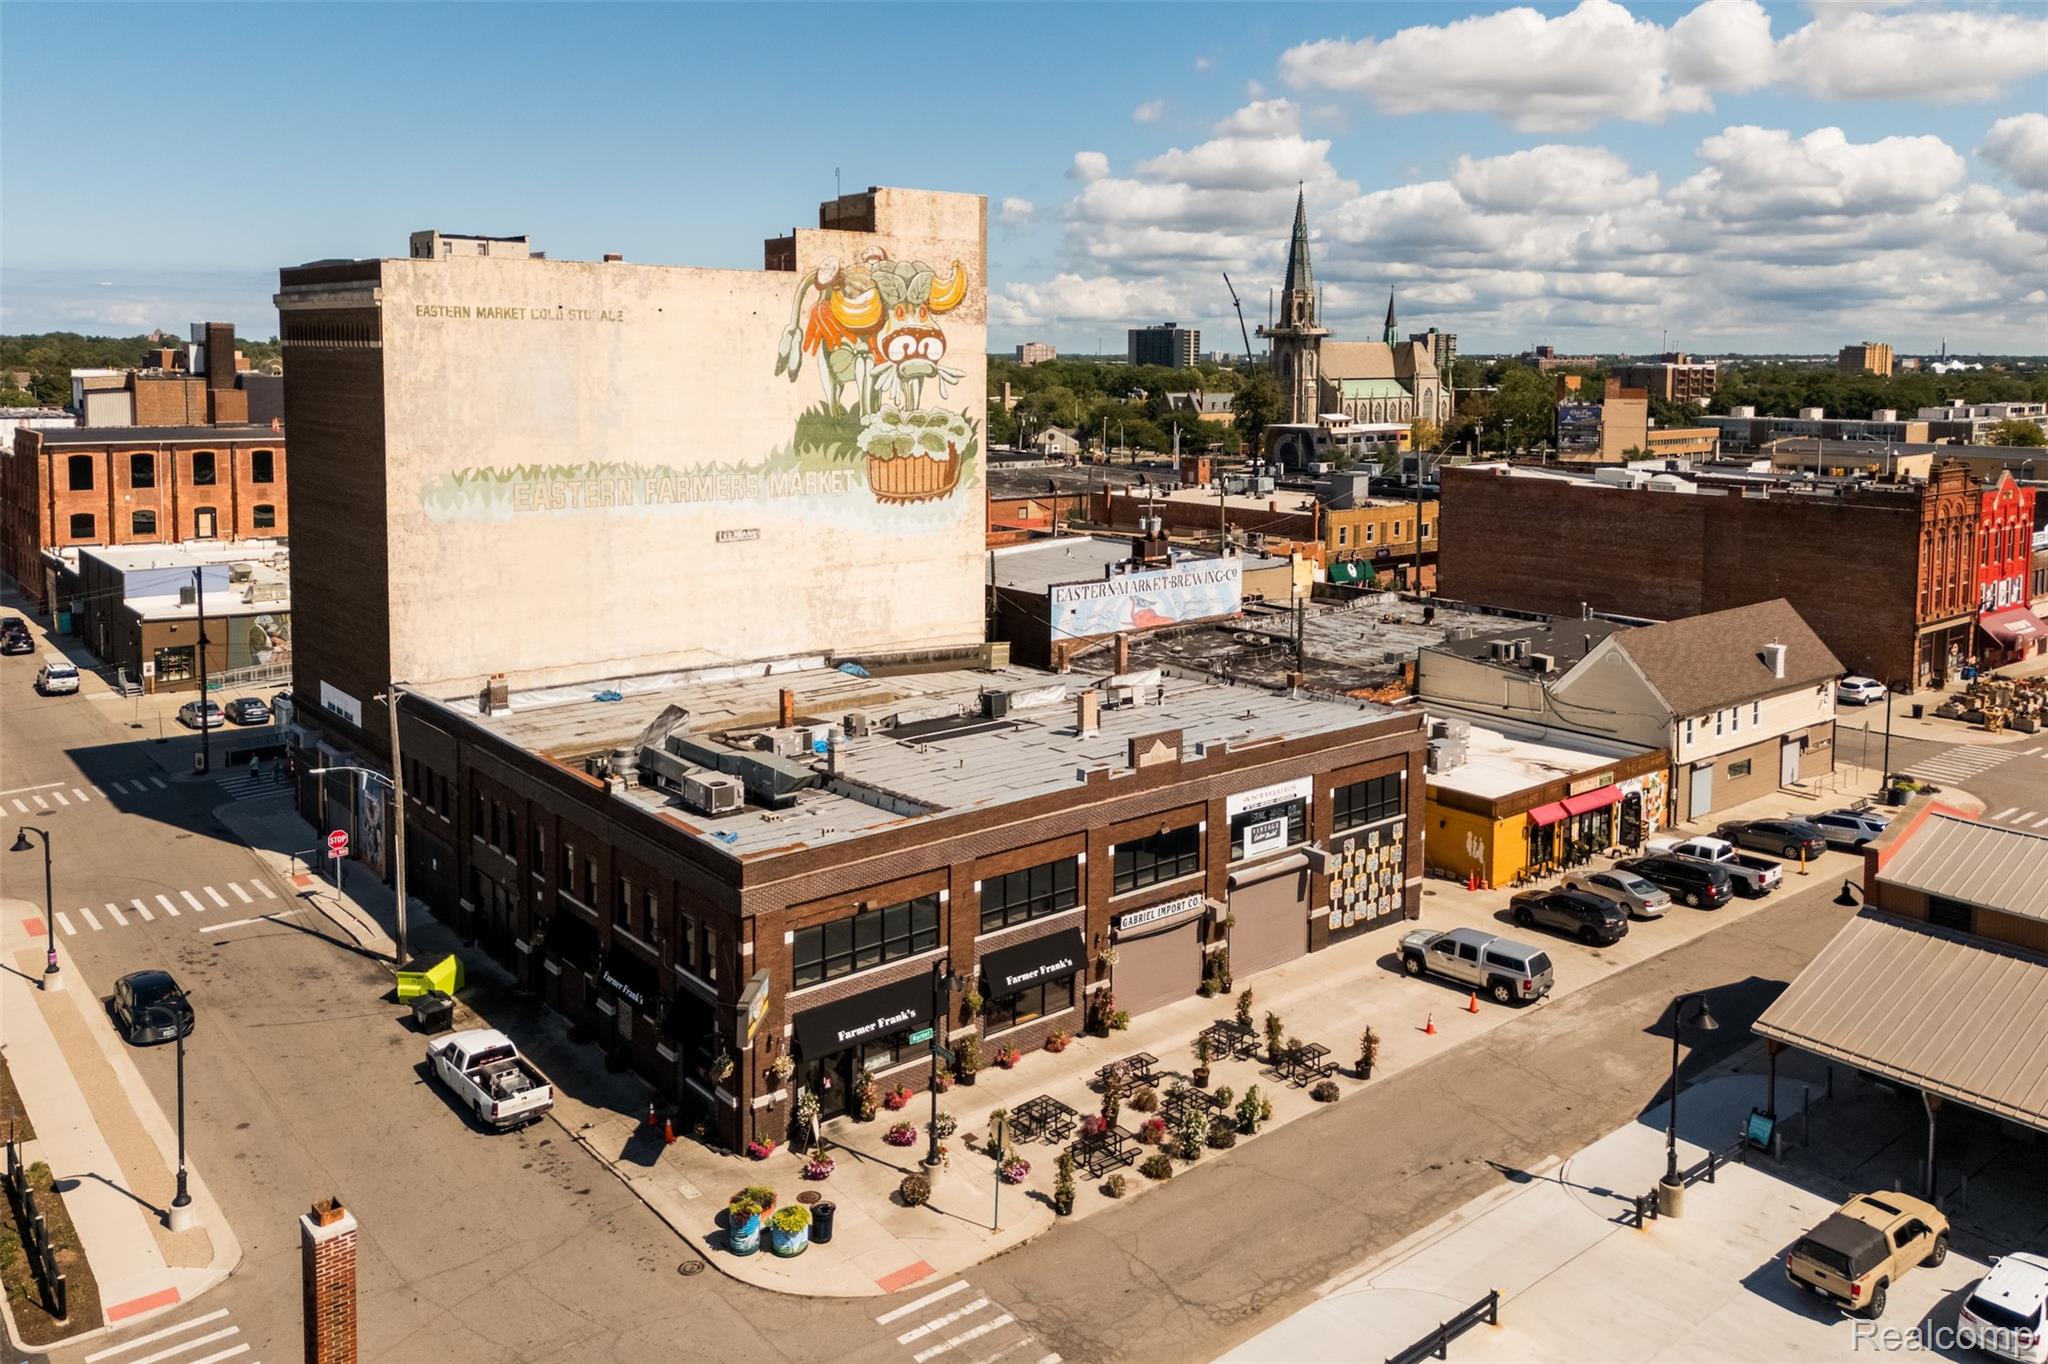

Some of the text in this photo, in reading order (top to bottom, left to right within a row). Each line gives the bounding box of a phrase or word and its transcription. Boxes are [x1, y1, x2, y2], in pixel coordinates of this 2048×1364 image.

[416, 305, 471, 318] EASTERN
[476, 306, 526, 320] MARKET
[513, 469, 855, 512] EASTERN FARMERS MARKET
[330, 835, 347, 845] STOP
[1122, 910, 1155, 928] GABRIEL
[1157, 901, 1186, 917] IMPORT
[1006, 958, 1073, 986] Farmer Frank's
[603, 970, 644, 1006] Farmer Frank's
[837, 1008, 917, 1041] Farmer Frank's
